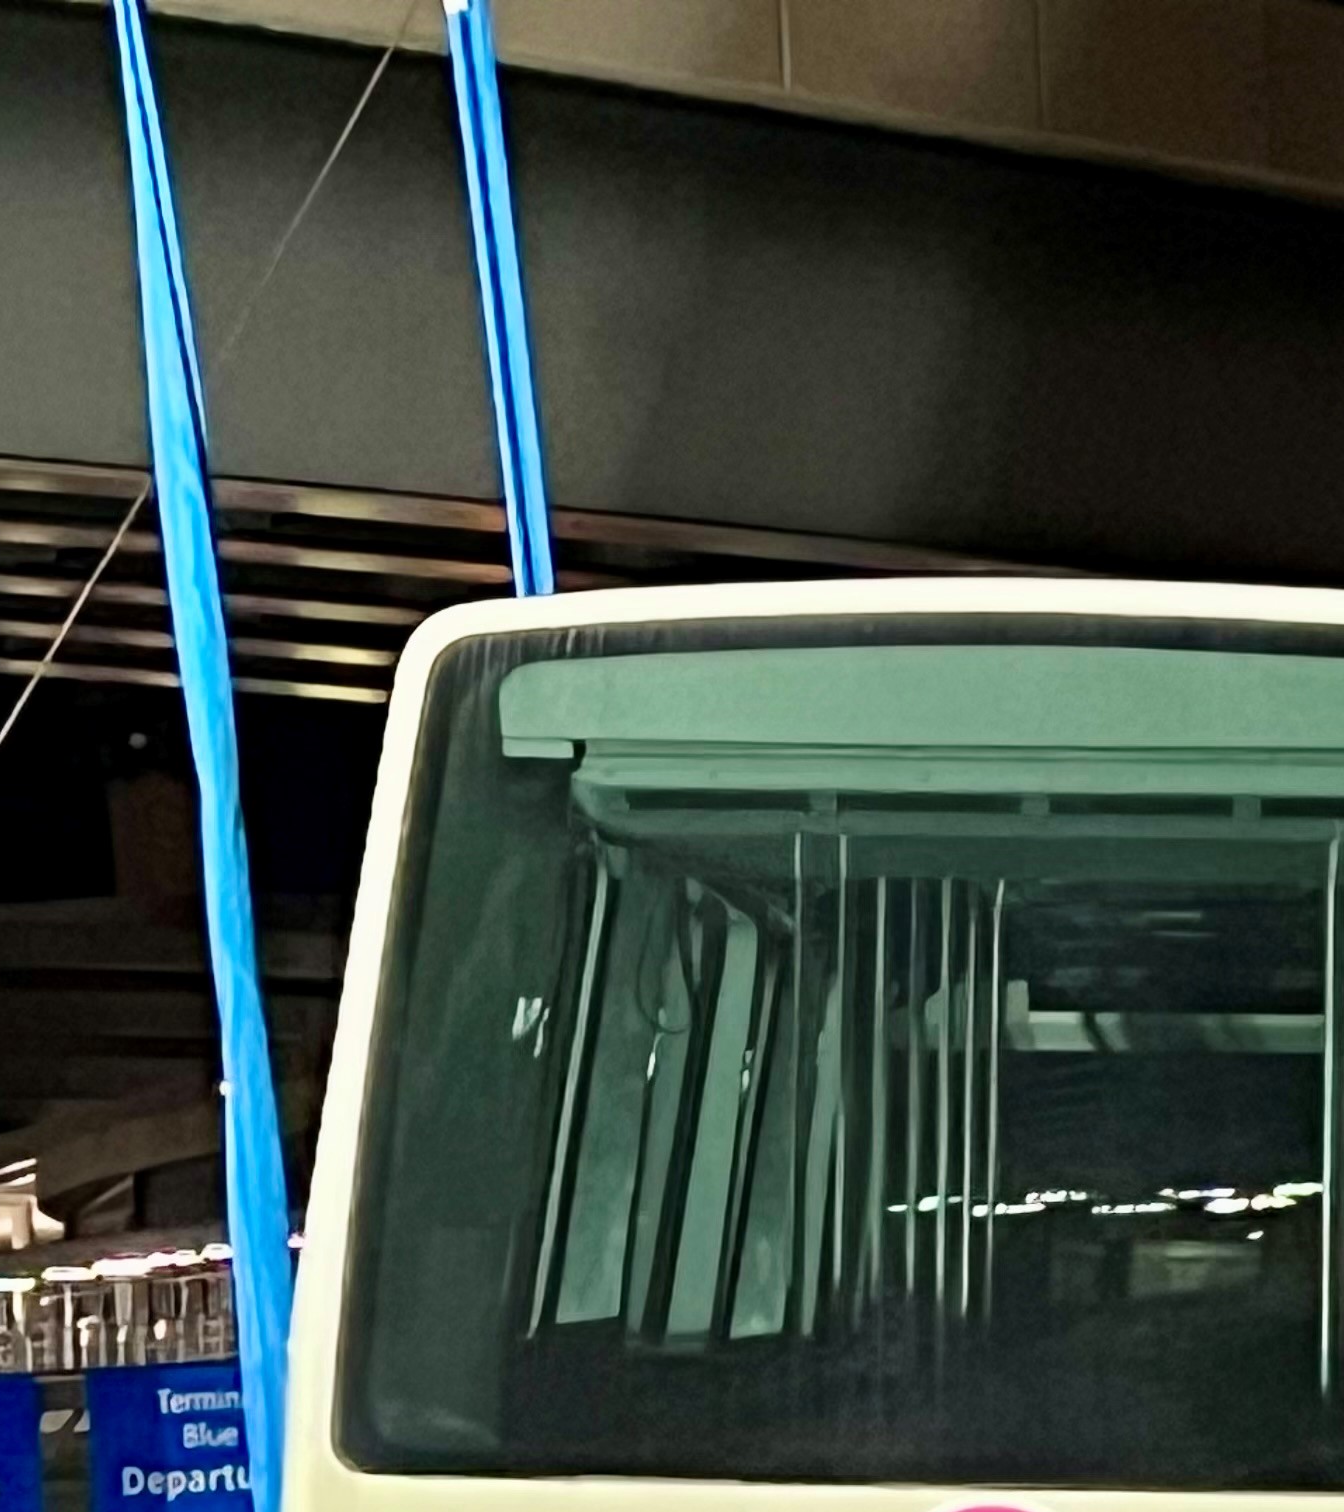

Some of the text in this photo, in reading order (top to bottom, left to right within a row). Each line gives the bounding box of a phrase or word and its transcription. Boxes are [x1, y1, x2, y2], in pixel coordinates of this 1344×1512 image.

[157, 1388, 243, 1414] Termin
[183, 1421, 239, 1448] Blue
[122, 1464, 252, 1502] Departu
